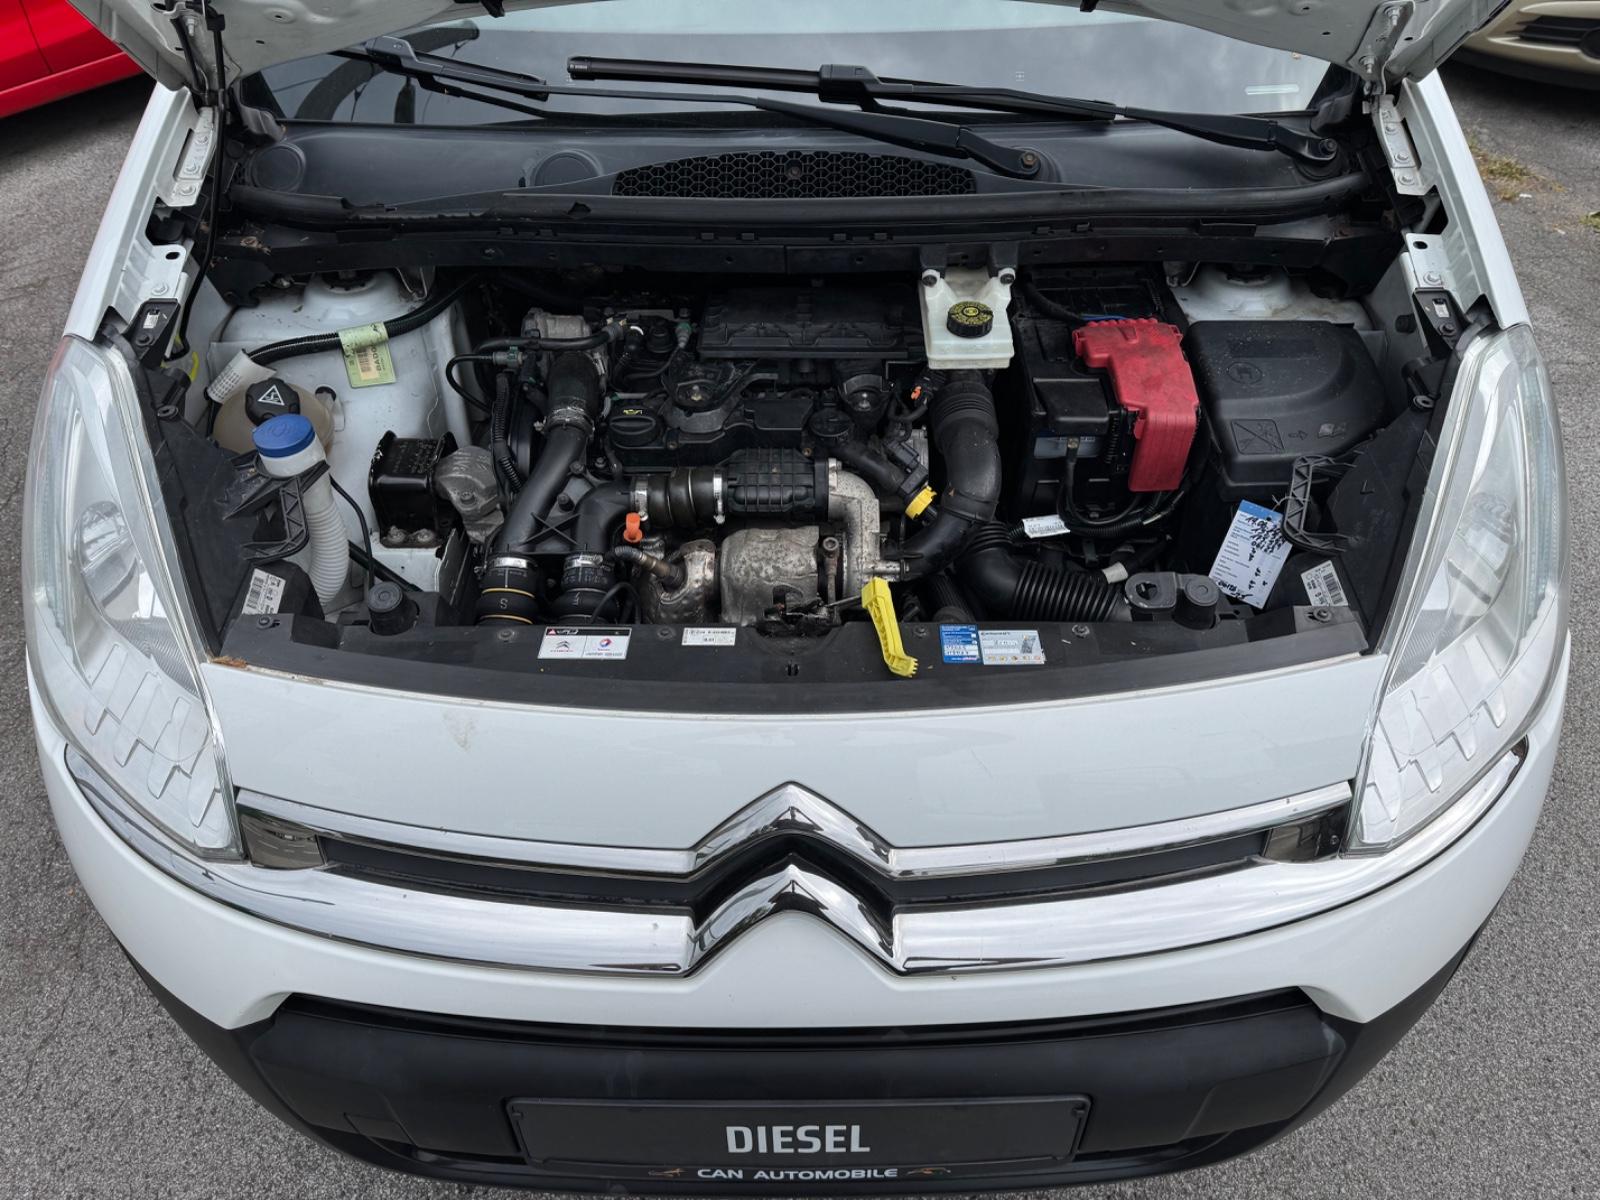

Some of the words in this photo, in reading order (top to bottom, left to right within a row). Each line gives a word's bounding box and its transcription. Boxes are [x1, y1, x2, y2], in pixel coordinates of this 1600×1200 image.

[500, 598, 508, 609] S
[726, 1125, 870, 1153] DIESEL
[697, 1169, 743, 1179] CAN
[753, 1168, 898, 1180] AUTOMOBILE
